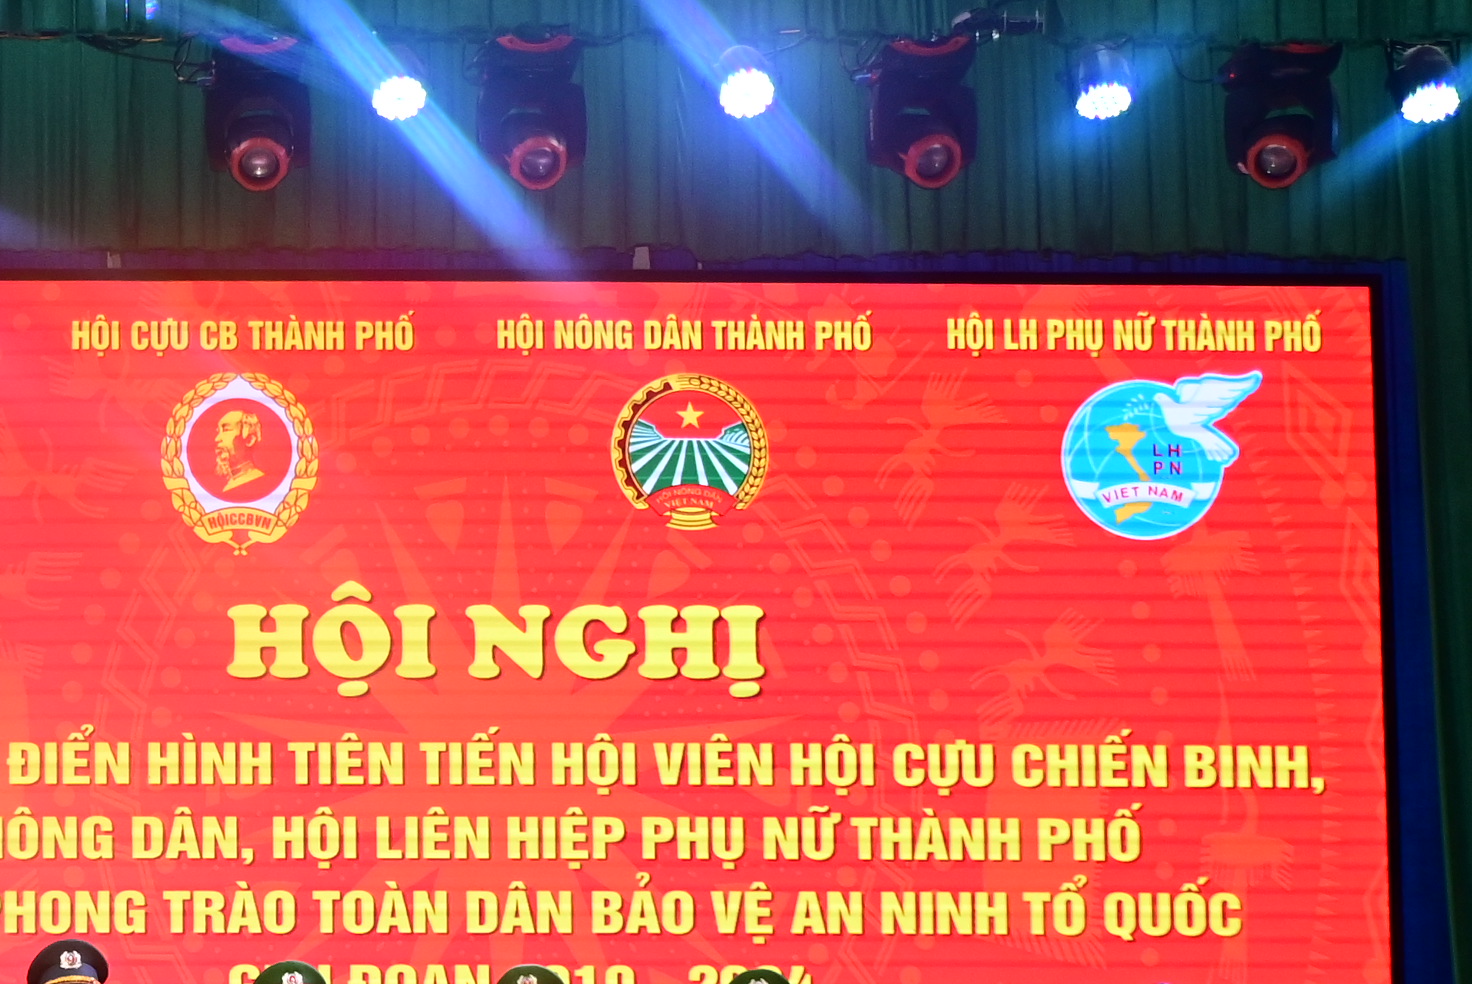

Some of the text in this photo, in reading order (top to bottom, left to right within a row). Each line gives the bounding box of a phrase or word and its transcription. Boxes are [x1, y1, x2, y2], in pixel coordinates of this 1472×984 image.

[71, 310, 414, 357] HỘI CỰU CB THÀNH PHỐ
[497, 310, 872, 356] HỘI NÔNG DÂN THÀNH PHỐ
[947, 309, 1322, 358] HỘI LH PHỤ NỮ THÀNH PHỐ
[1148, 486, 1183, 502] NAM
[226, 579, 765, 698] HỘI NGHỊ
[5, 723, 130, 785] ĐIỂN
[147, 732, 272, 785] HÌNH
[287, 732, 404, 785] TIÊN
[418, 725, 535, 786] TIẾN
[551, 732, 636, 796] HỘI
[652, 732, 774, 786] VIÊN
[789, 733, 875, 796] HỘI
[892, 739, 994, 796] CỰU
[1011, 728, 1168, 788] CHIẾN
[1184, 744, 1325, 794] BINH,
[131, 806, 254, 865] DÂN,
[272, 806, 357, 869] HỘI
[375, 806, 490, 859] LIÊN
[506, 806, 625, 870] HIỆP
[641, 816, 745, 870] PHỤ
[762, 805, 842, 861] NỮ
[857, 807, 1021, 861] THÀNH
[1037, 802, 1142, 862] PHỐ
[162, 880, 296, 935] TRÀO
[311, 880, 448, 935] TOÀN
[465, 880, 573, 934] DÂN
[591, 873, 694, 935] BẢO
[710, 881, 774, 945] VỆ
[790, 890, 863, 935] AN
[880, 891, 1008, 935] NINH
[1022, 873, 1088, 936] TỔ
[1103, 876, 1242, 941] QUỐC
